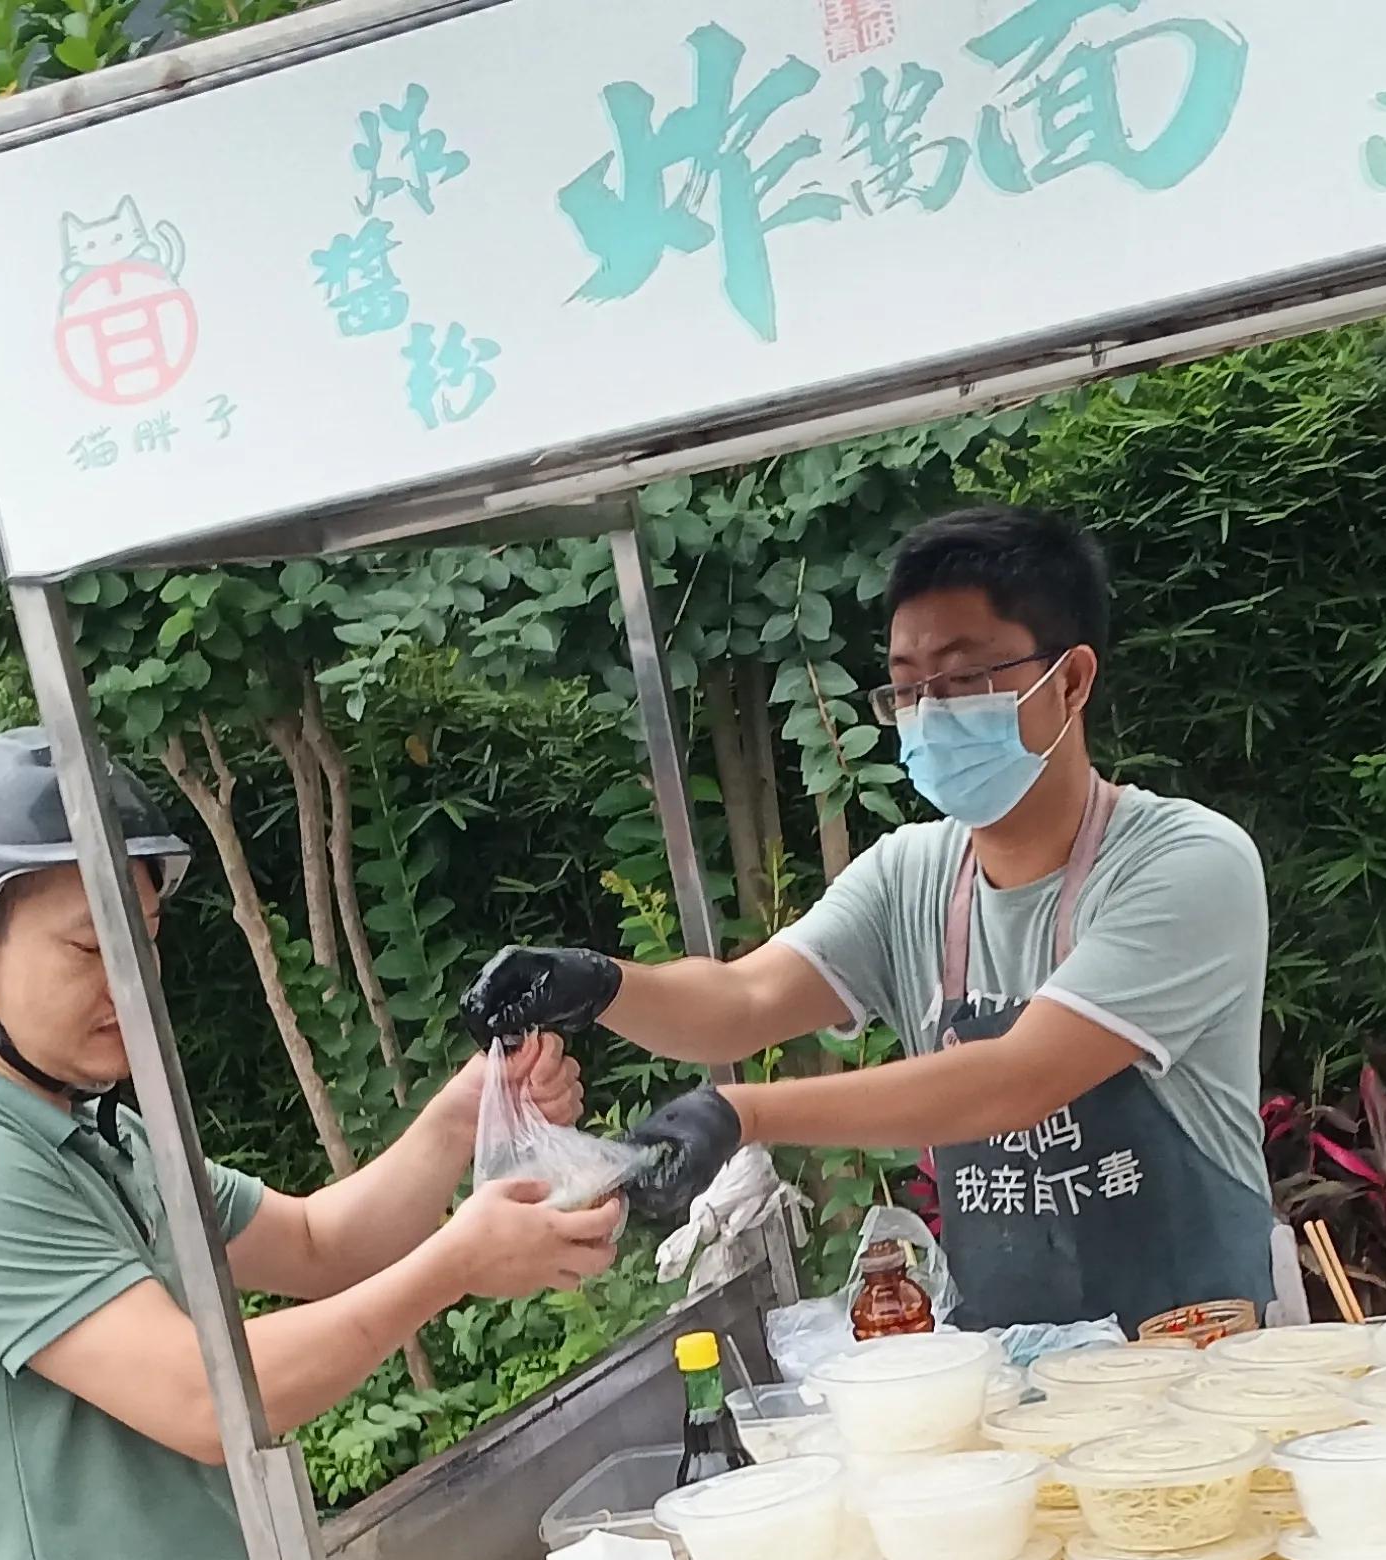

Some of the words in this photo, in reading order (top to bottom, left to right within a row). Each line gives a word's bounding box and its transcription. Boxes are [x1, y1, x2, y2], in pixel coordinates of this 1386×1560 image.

[955, 1147, 1144, 1217] 我亲自下毒
